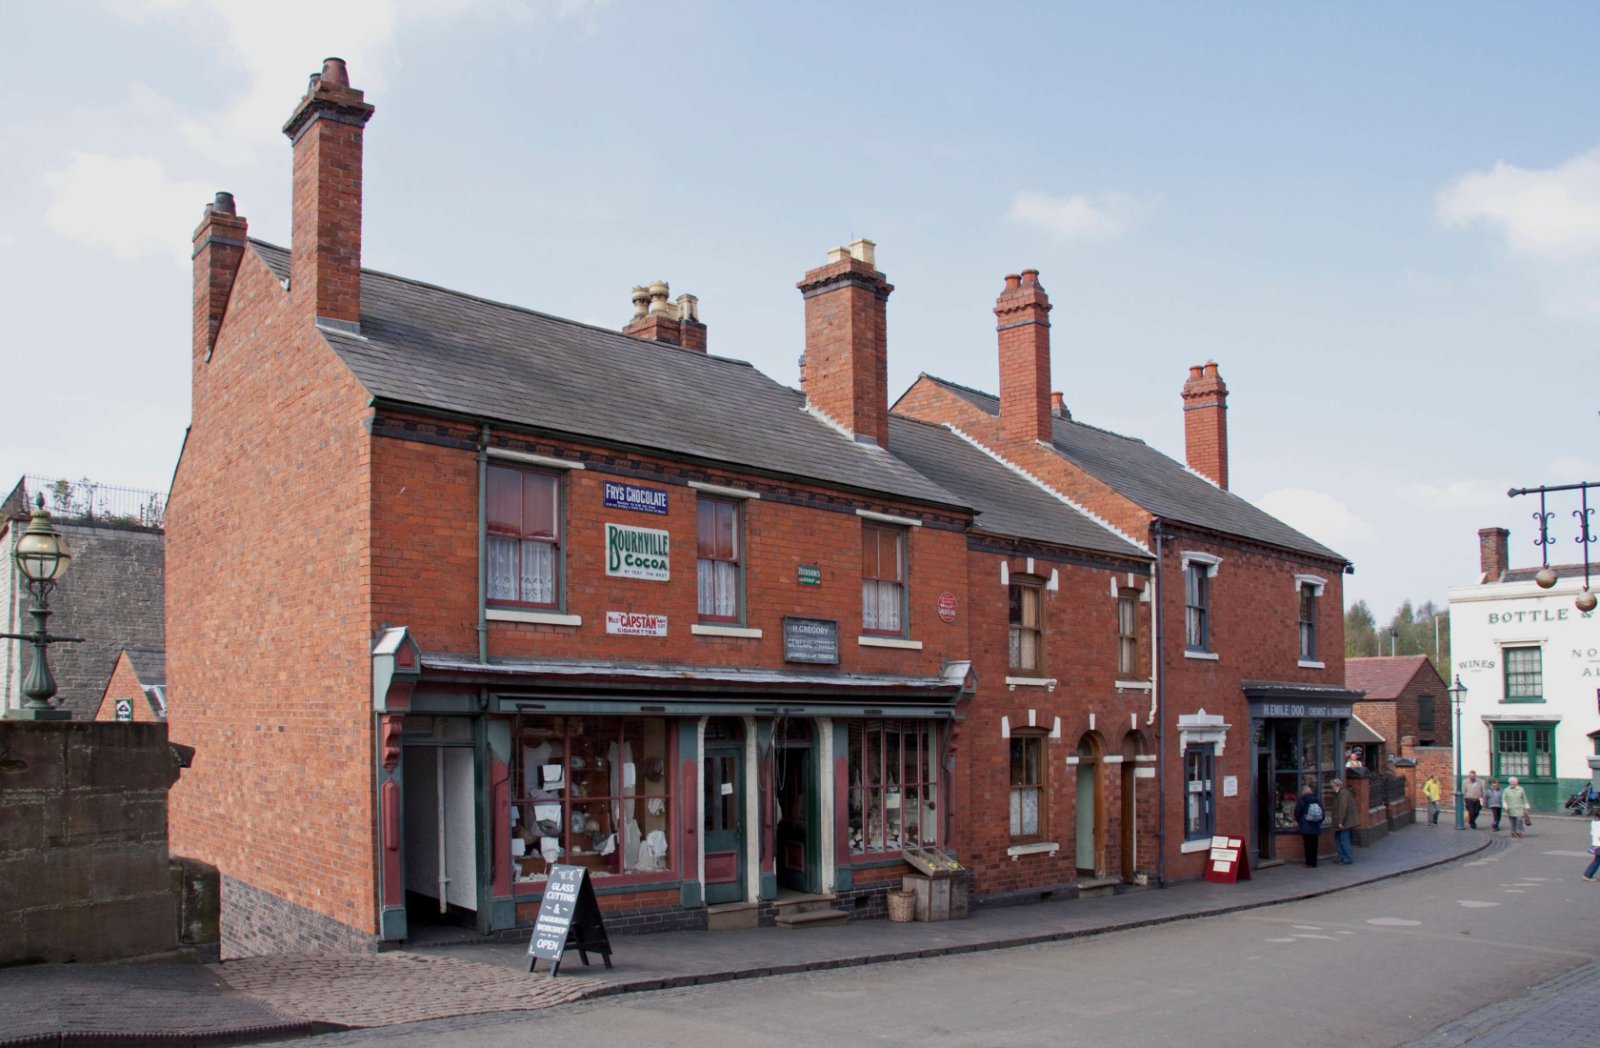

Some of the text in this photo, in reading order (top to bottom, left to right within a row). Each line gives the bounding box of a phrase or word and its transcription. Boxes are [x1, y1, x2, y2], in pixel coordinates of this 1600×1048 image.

[606, 483, 624, 501] FRY'S
[626, 487, 666, 507] CHOCOLATE
[608, 525, 668, 572] BOURNVILLE
[624, 554, 667, 571] COCOA
[1488, 608, 1569, 624] BOTTLE
[1458, 660, 1495, 669] WINES
[1291, 705, 1305, 716] DOO
[551, 882, 575, 893] GLASS
[546, 892, 575, 902] CUTTING
[553, 903, 560, 914] &
[536, 938, 559, 951] OPEN
